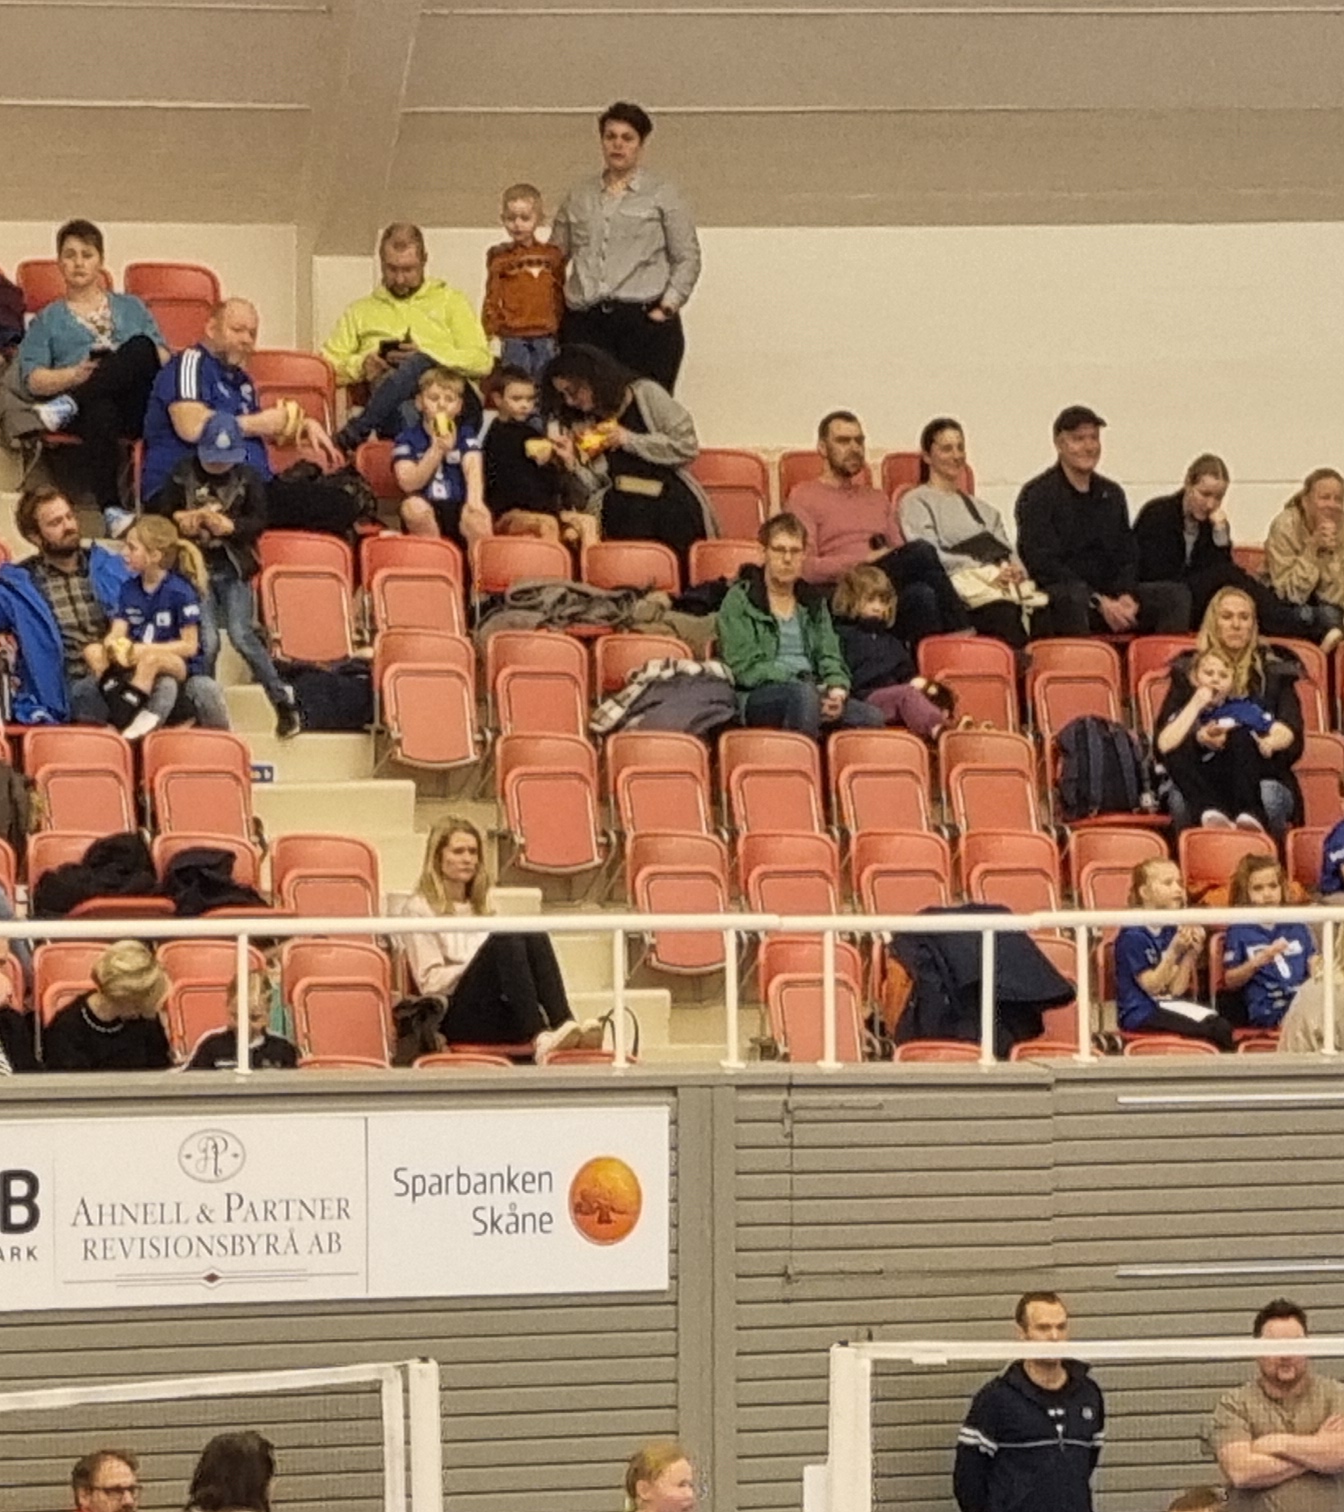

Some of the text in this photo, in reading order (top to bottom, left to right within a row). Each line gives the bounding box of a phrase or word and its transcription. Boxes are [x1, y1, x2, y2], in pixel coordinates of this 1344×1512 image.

[392, 1164, 554, 1203] Sparbanken
[196, 1202, 215, 1225] &
[471, 1204, 554, 1236] Skåne
[81, 1227, 344, 1262] REVISIONSBYRÅ AB
